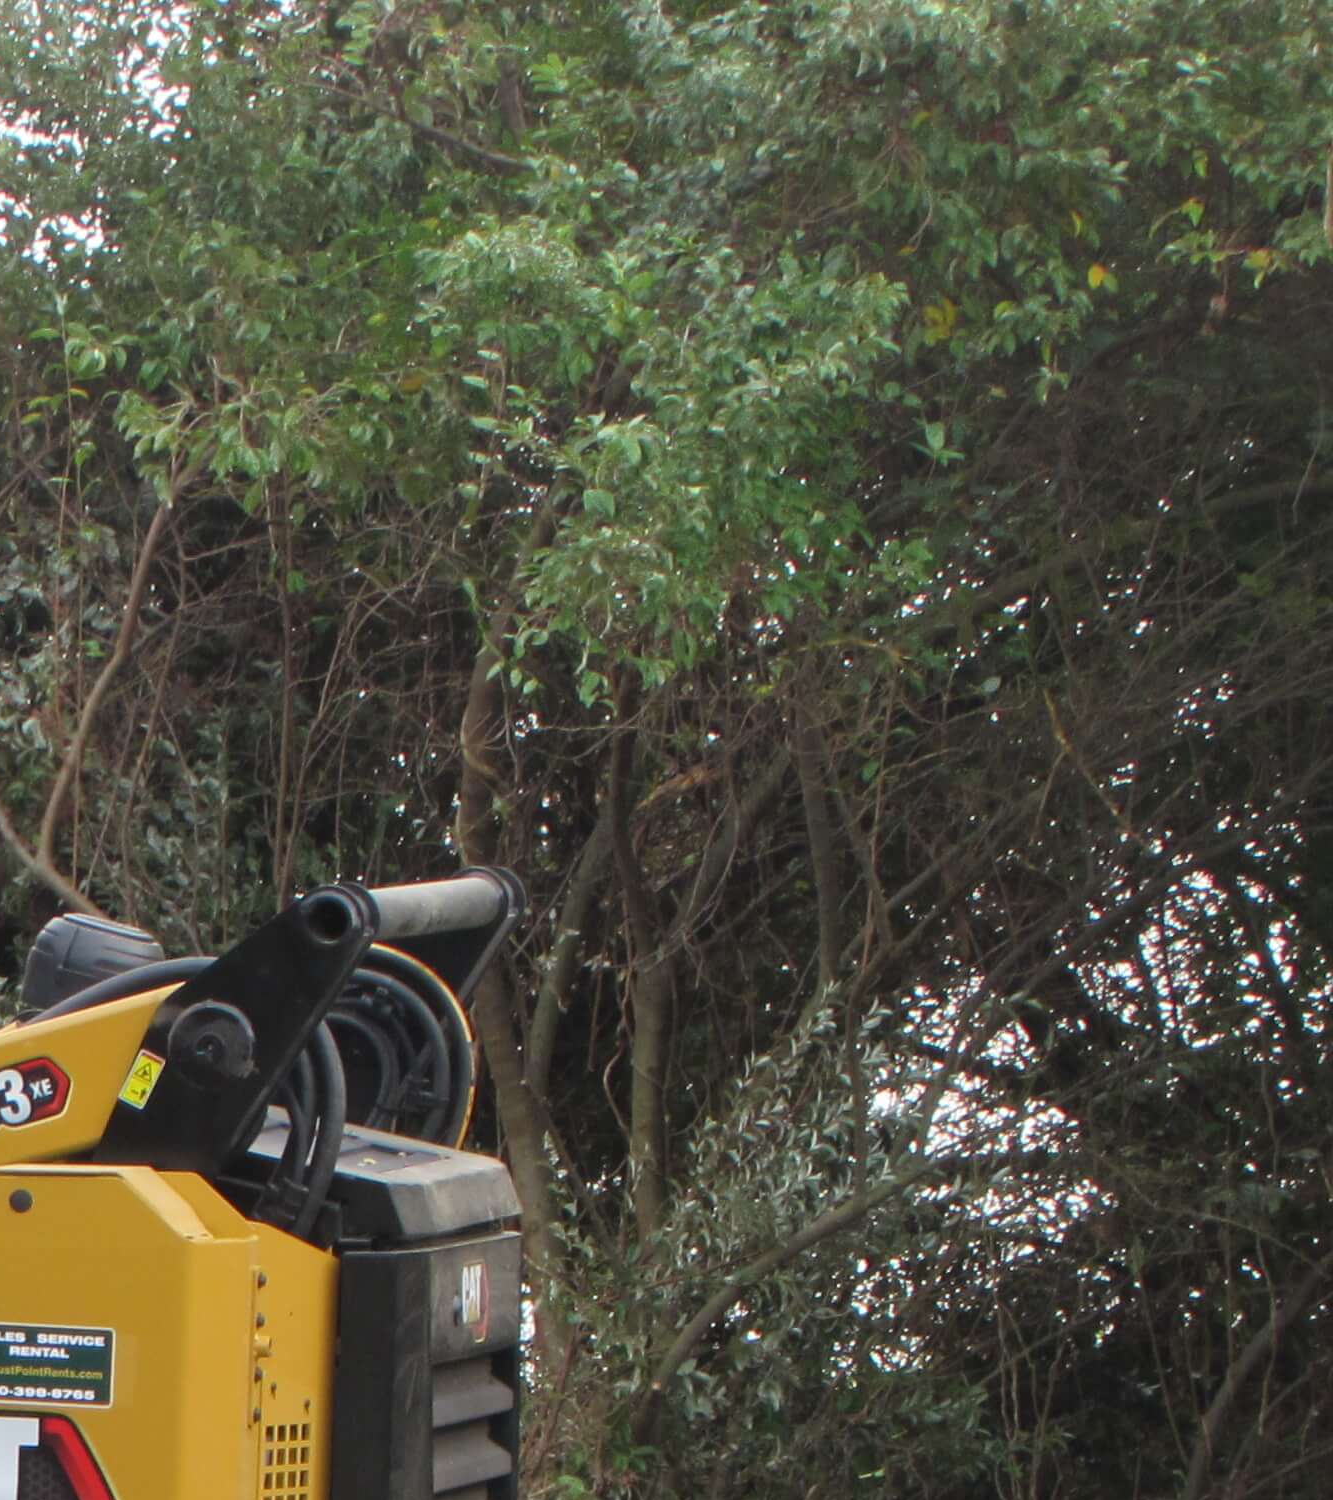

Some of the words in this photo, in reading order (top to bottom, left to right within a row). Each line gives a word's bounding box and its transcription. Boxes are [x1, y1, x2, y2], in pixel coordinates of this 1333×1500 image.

[29, 1078, 53, 1100] XE
[37, 1333, 106, 1347] SERVICE
[9, 1346, 70, 1359] RENTAL
